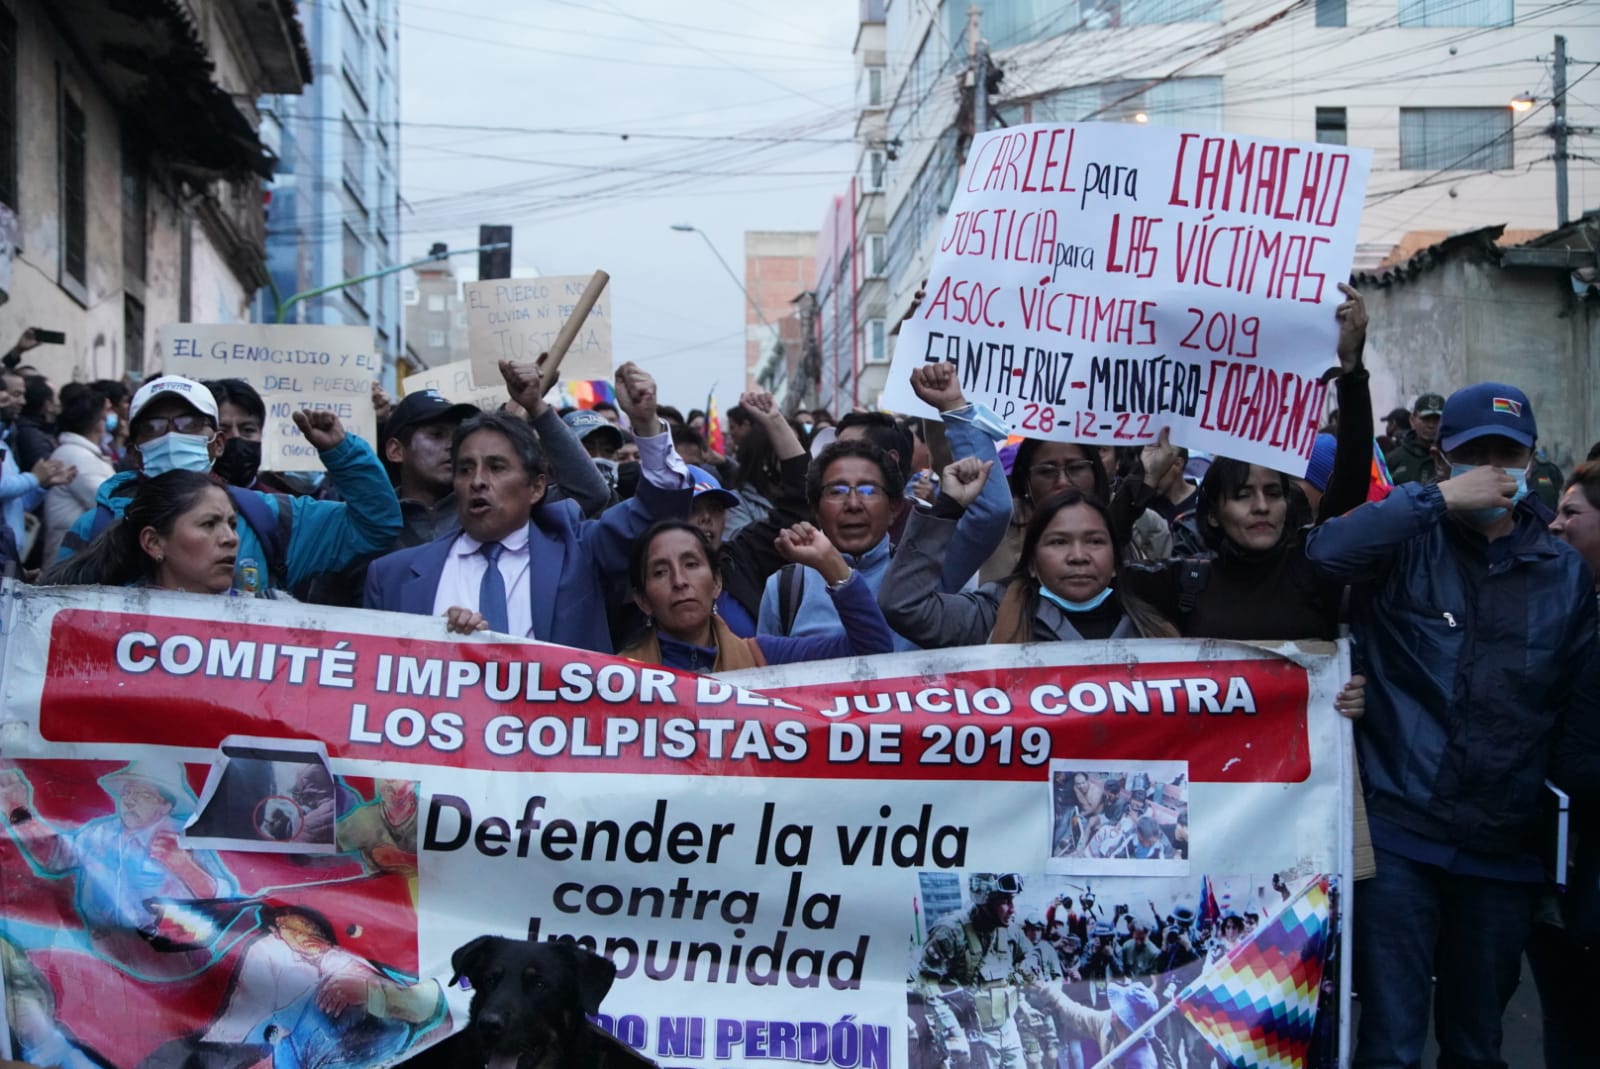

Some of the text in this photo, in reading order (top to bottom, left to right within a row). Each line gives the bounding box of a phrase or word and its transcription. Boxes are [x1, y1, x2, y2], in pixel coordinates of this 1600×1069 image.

[966, 128, 1350, 227] CARCEL para CAMACHO
[1052, 240, 1094, 283] para
[1106, 213, 1163, 278] LAS
[488, 307, 530, 324] OLVIDA
[496, 285, 549, 304] PUEBLO
[924, 275, 1260, 358] ASOC. VÍCTIMAS 2019
[173, 339, 203, 358] EL
[210, 341, 330, 366] GENOCIDIO
[356, 354, 375, 371] EL
[263, 375, 303, 392] DEL
[312, 376, 370, 394] PUEBLO
[270, 402, 291, 418] NO
[1022, 403, 1154, 440] 28-12-22
[115, 631, 358, 689] COMITÉ
[375, 654, 677, 703] IMPULSOR
[819, 687, 1014, 717] JUICIO
[1030, 676, 1257, 715] CONTRA
[348, 704, 1051, 765] LOS GOLPISTAS DE 2019
[423, 794, 970, 868] Defender la vida
[552, 871, 841, 930] contra la
[657, 1016, 704, 1058] NI
[715, 1014, 891, 1069] PERDÓN
